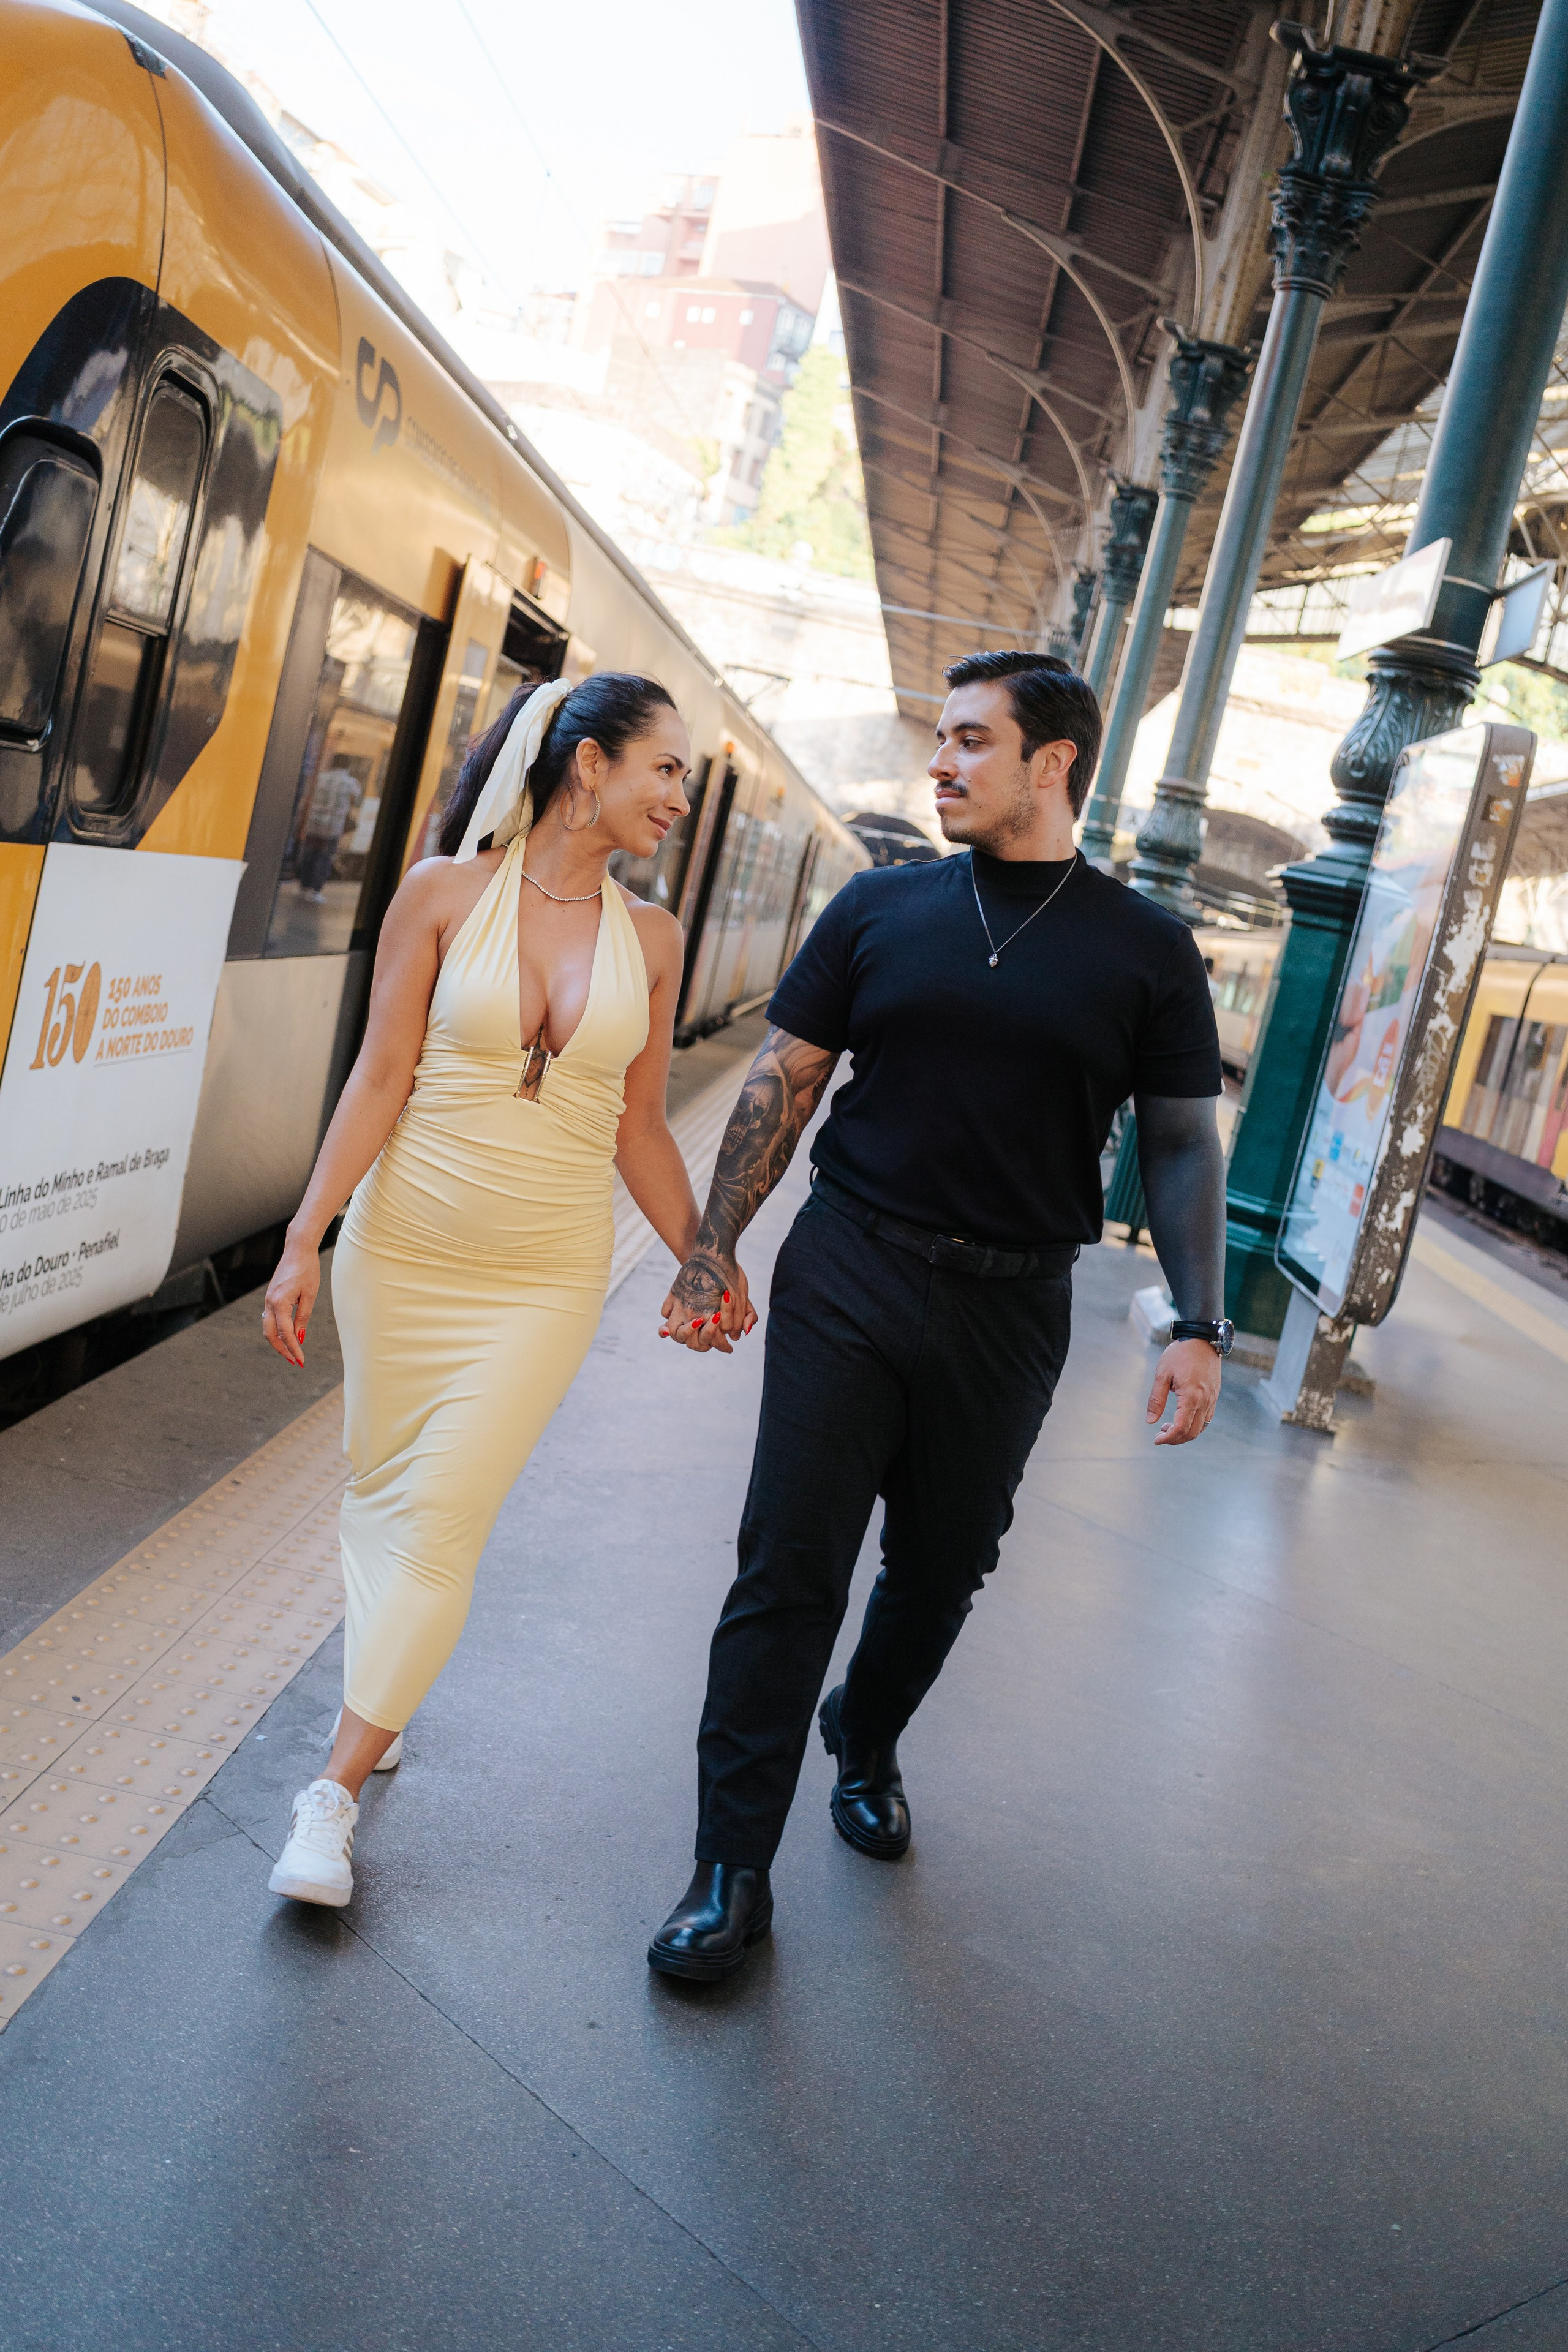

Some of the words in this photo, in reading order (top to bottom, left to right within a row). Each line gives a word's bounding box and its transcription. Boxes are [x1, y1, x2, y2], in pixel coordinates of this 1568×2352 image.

[108, 976, 131, 1004] 150
[132, 974, 162, 997] ANOS
[29, 959, 102, 1071] 150
[102, 1006, 120, 1030] DO
[121, 1001, 168, 1027] COMBOIO
[95, 1038, 104, 1061] A
[106, 1032, 144, 1059] NORTE
[143, 1031, 159, 1054] DO
[159, 1025, 194, 1051] DOURO
[34, 1176, 50, 1199] do
[51, 1167, 85, 1195] Minho
[86, 1169, 94, 1185] e
[96, 1153, 129, 1181] Ramal
[129, 1152, 142, 1172] de
[143, 1147, 170, 1170] Braga
[10, 1205, 27, 1231] de
[28, 1196, 55, 1225] maio
[57, 1193, 72, 1216] de
[73, 1187, 99, 1210] 2025
[17, 1260, 31, 1283] do
[34, 1251, 69, 1276] Douro
[78, 1227, 121, 1262] Penafiel
[41, 1273, 56, 1297] de
[58, 1265, 83, 1291] 2025
